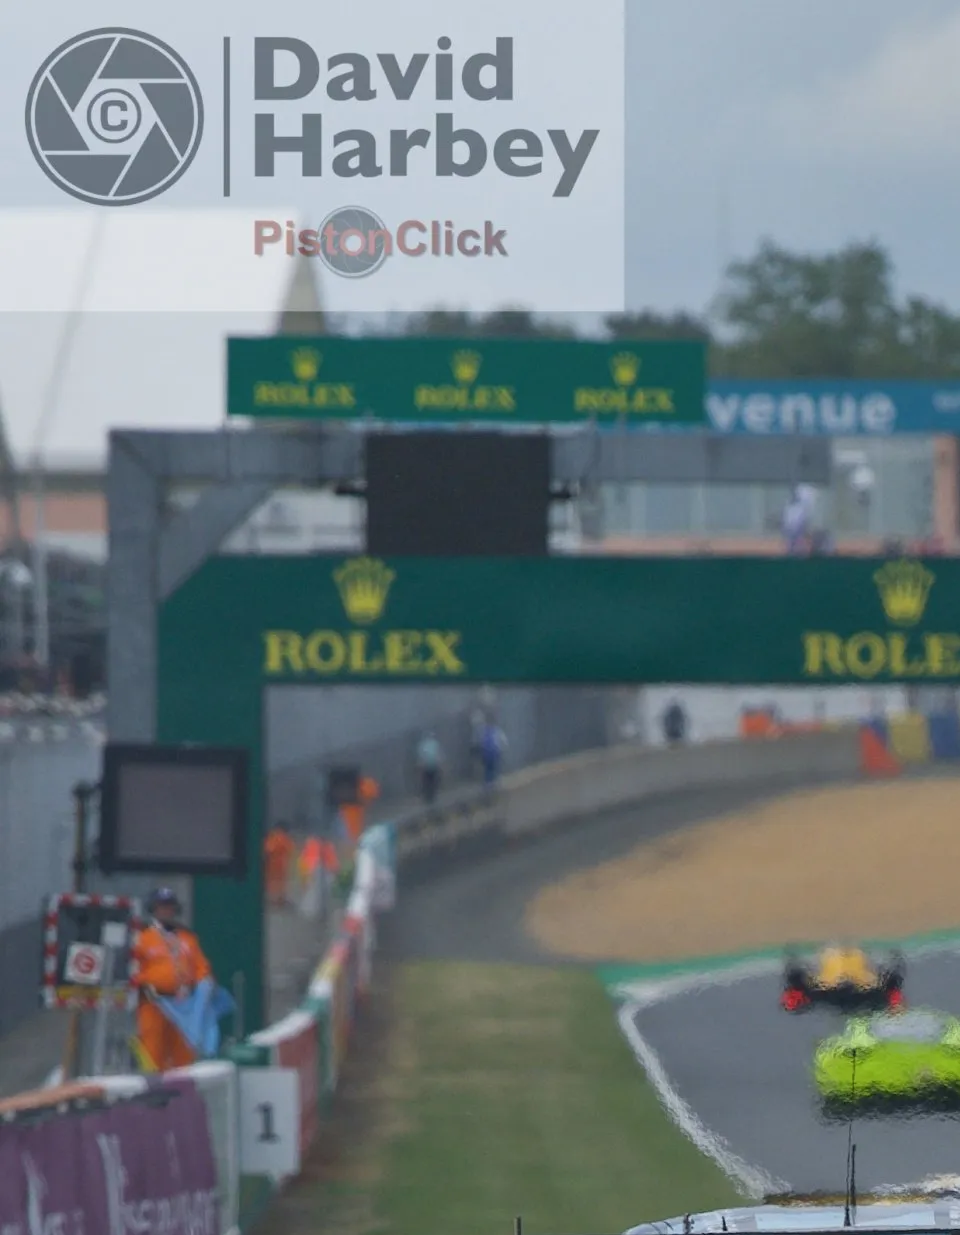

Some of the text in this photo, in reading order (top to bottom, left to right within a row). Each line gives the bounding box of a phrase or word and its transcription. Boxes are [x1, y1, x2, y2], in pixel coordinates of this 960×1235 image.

[253, 382, 356, 407] ROLEX
[414, 385, 517, 411] ROLEX
[574, 387, 675, 412] ROLEX
[704, 392, 897, 433] venue
[262, 630, 466, 676] ROLEX
[255, 1101, 281, 1144] 1
